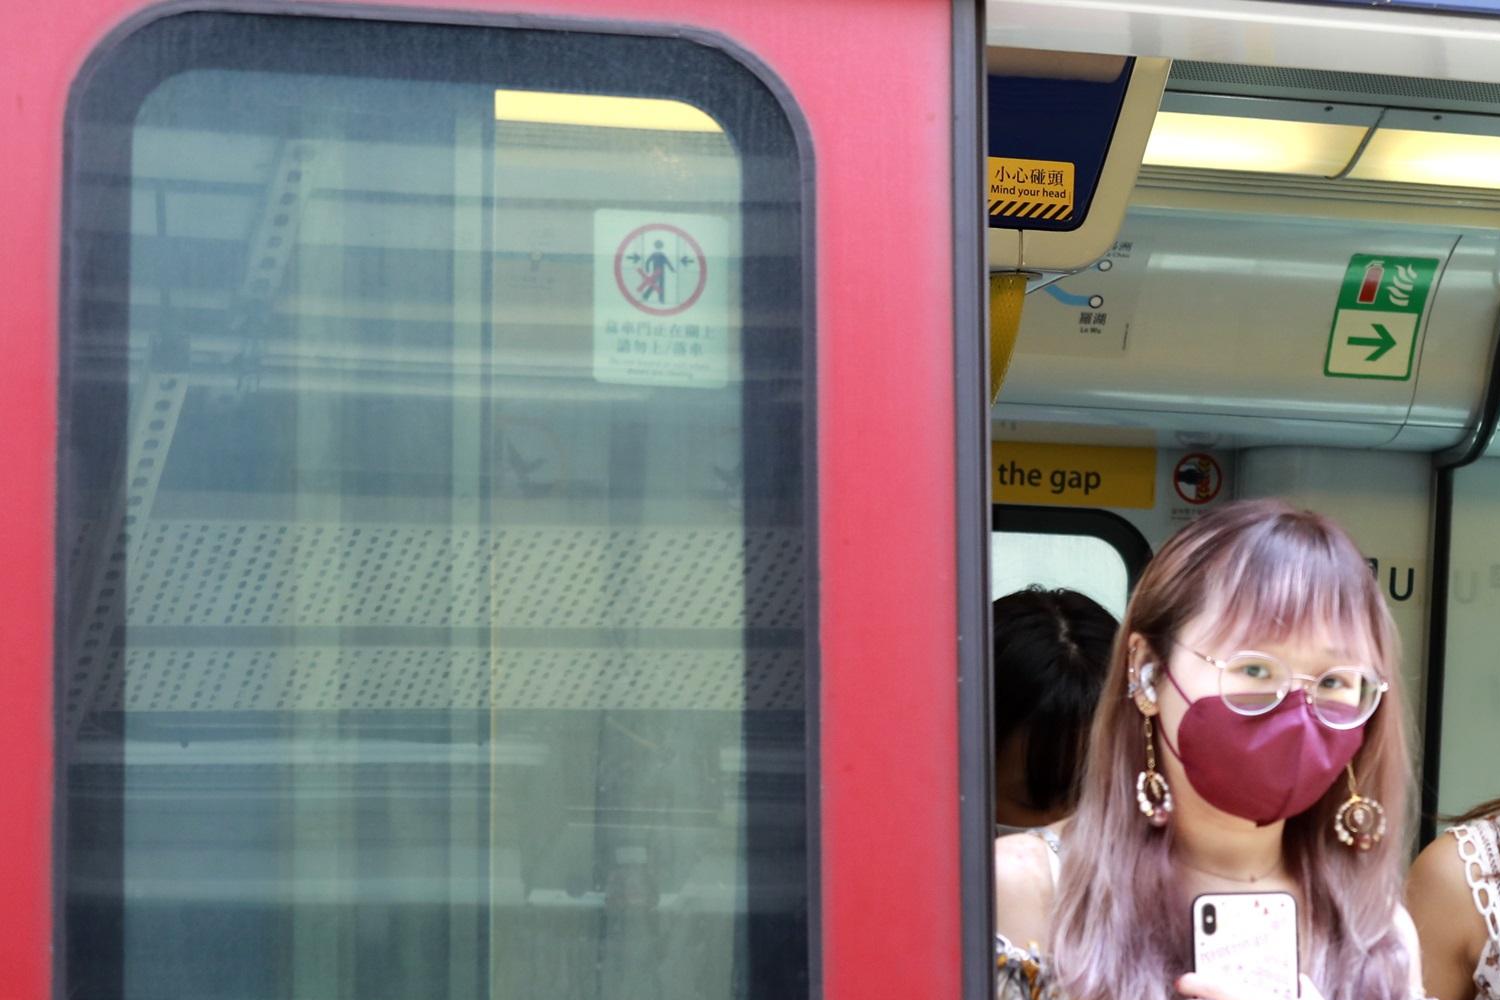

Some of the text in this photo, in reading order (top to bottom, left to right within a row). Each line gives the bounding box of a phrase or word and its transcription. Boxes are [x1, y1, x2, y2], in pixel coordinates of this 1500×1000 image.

[995, 166, 1064, 186] 小心碰頭
[991, 184, 1066, 199] Mind your head
[998, 461, 1101, 495] the gap
